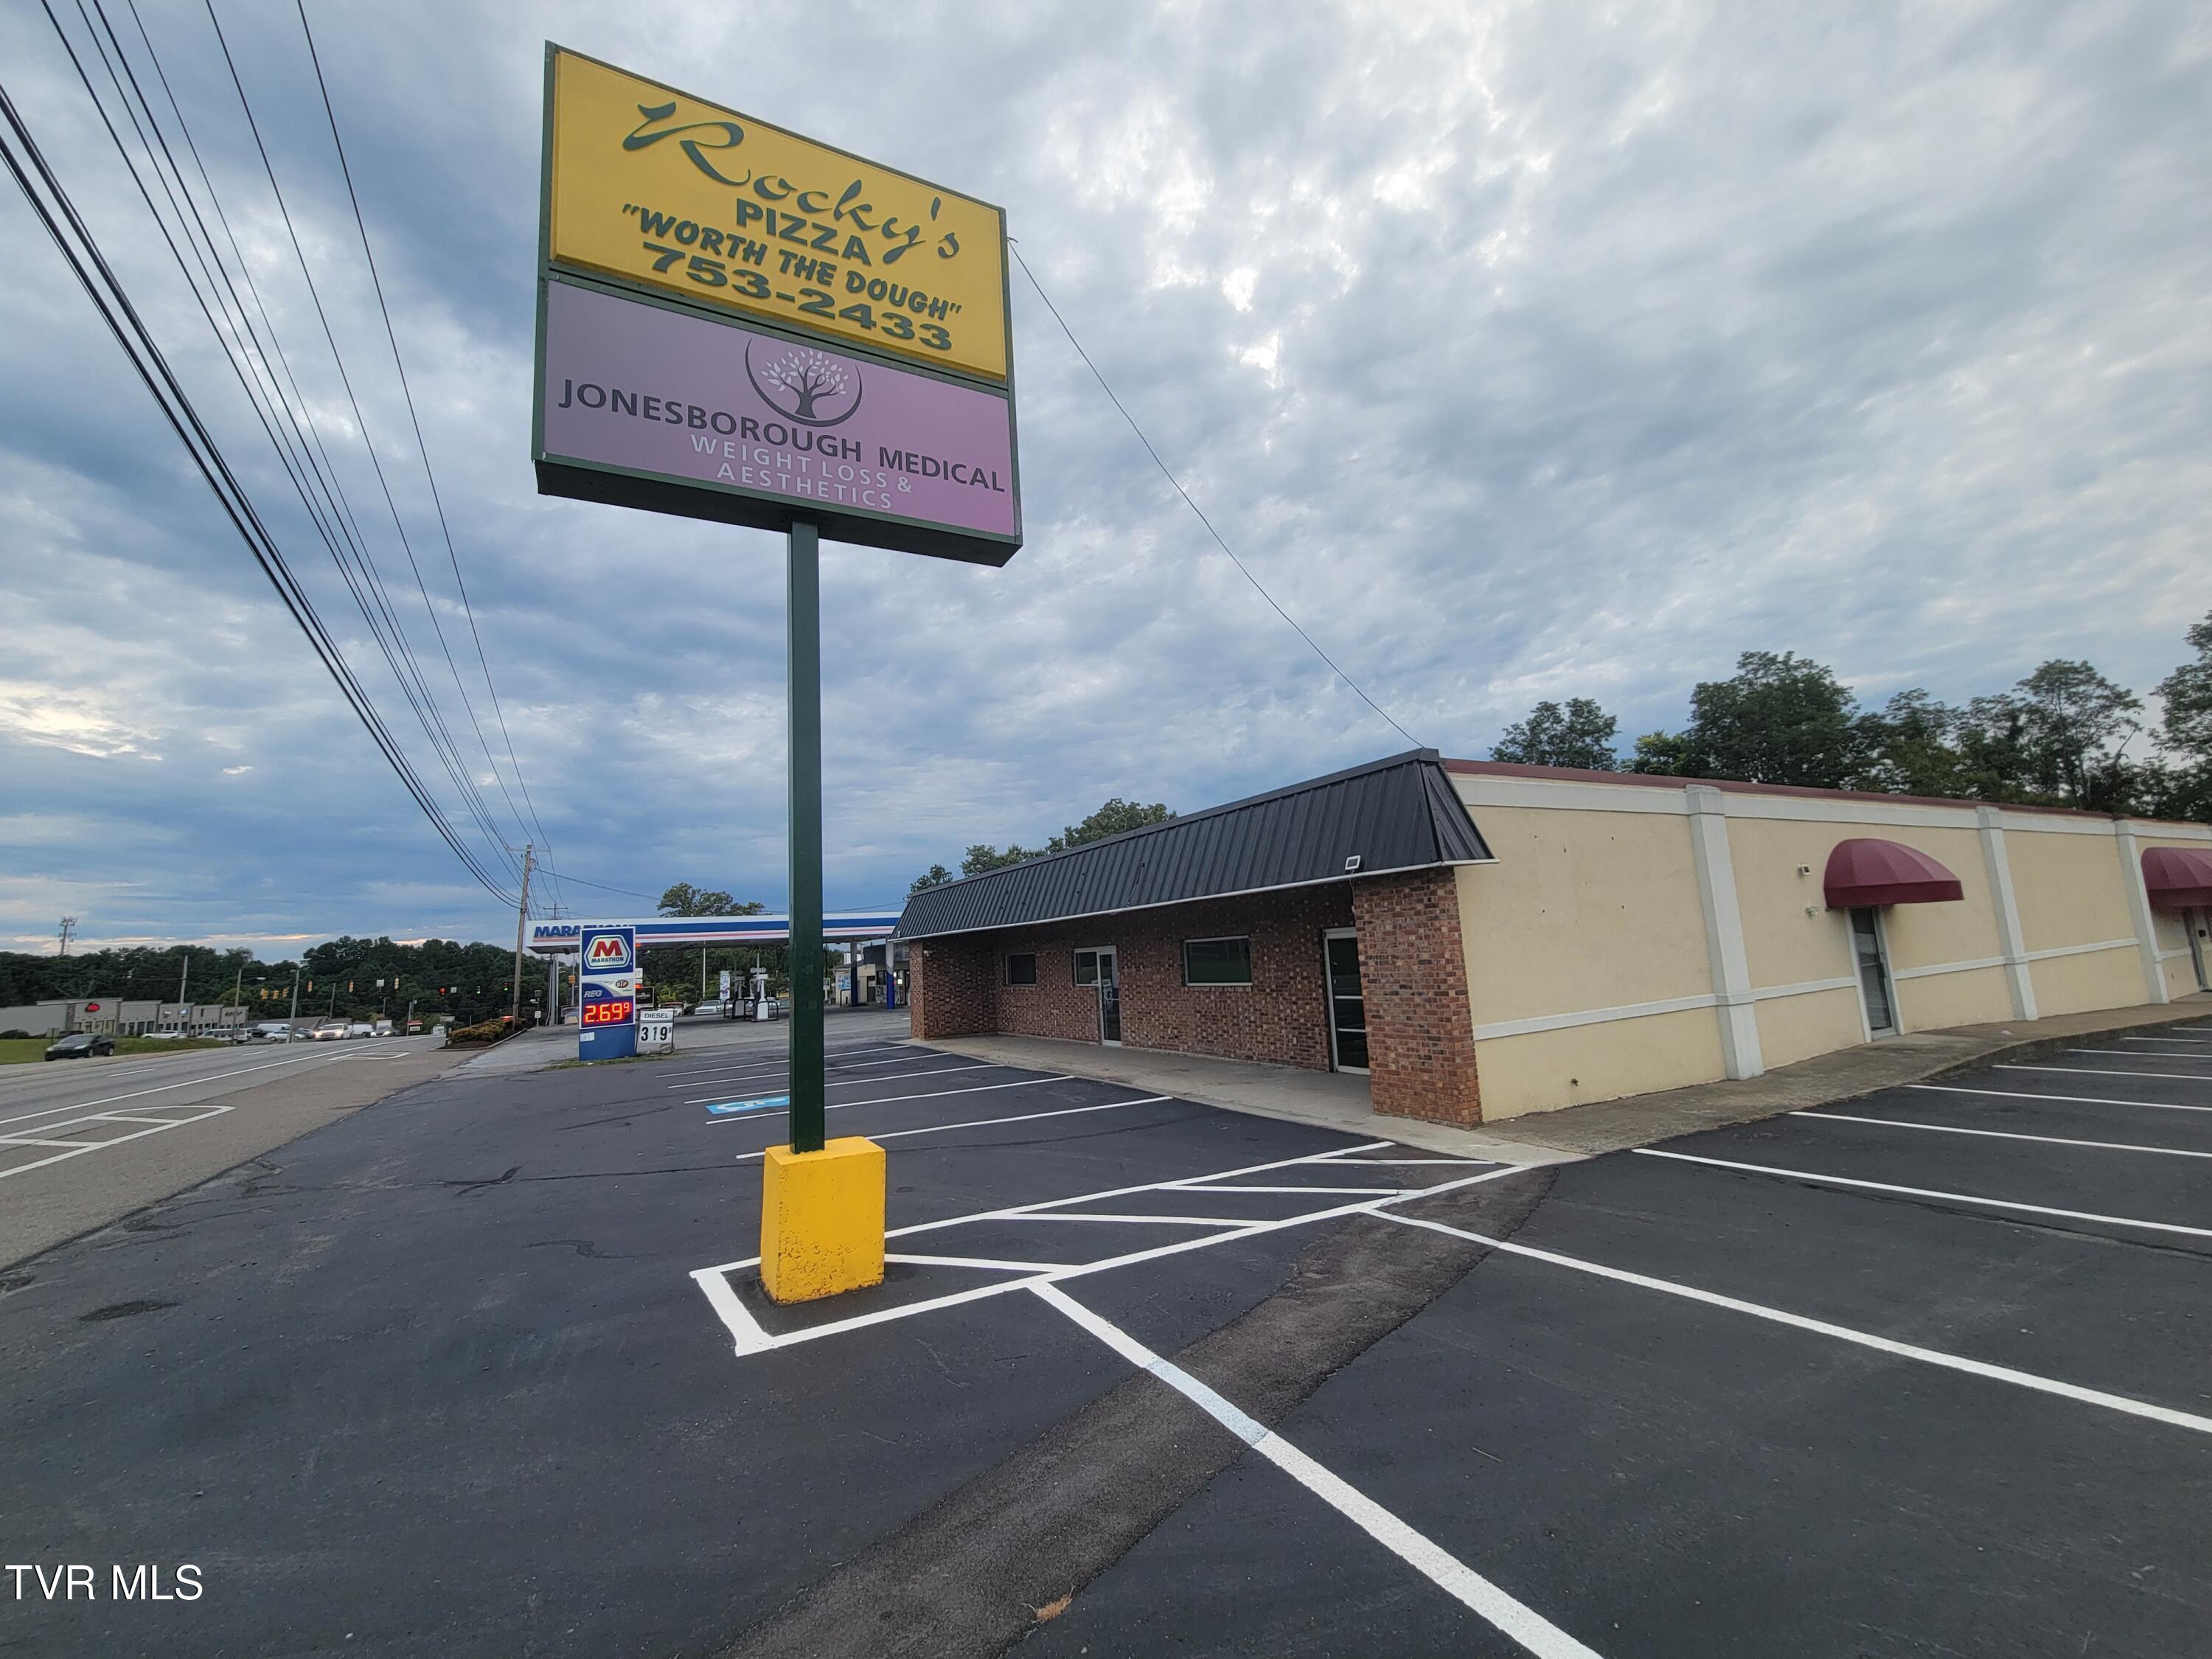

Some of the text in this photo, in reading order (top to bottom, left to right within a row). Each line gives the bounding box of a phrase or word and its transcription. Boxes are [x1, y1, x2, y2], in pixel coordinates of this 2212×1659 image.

[622, 101, 960, 264] Rocky's
[622, 203, 962, 320] "WORTH THE DOUGH"
[737, 198, 872, 267] PIZZA
[643, 241, 953, 350] 753-2433
[558, 379, 1005, 493] JONESBOROUGH MEDICAL
[690, 434, 912, 493] WEIGHT LOSS &
[717, 462, 892, 509] AESTHETICS
[592, 940, 623, 958] M
[584, 990, 602, 998] REG
[616, 980, 628, 988] STP
